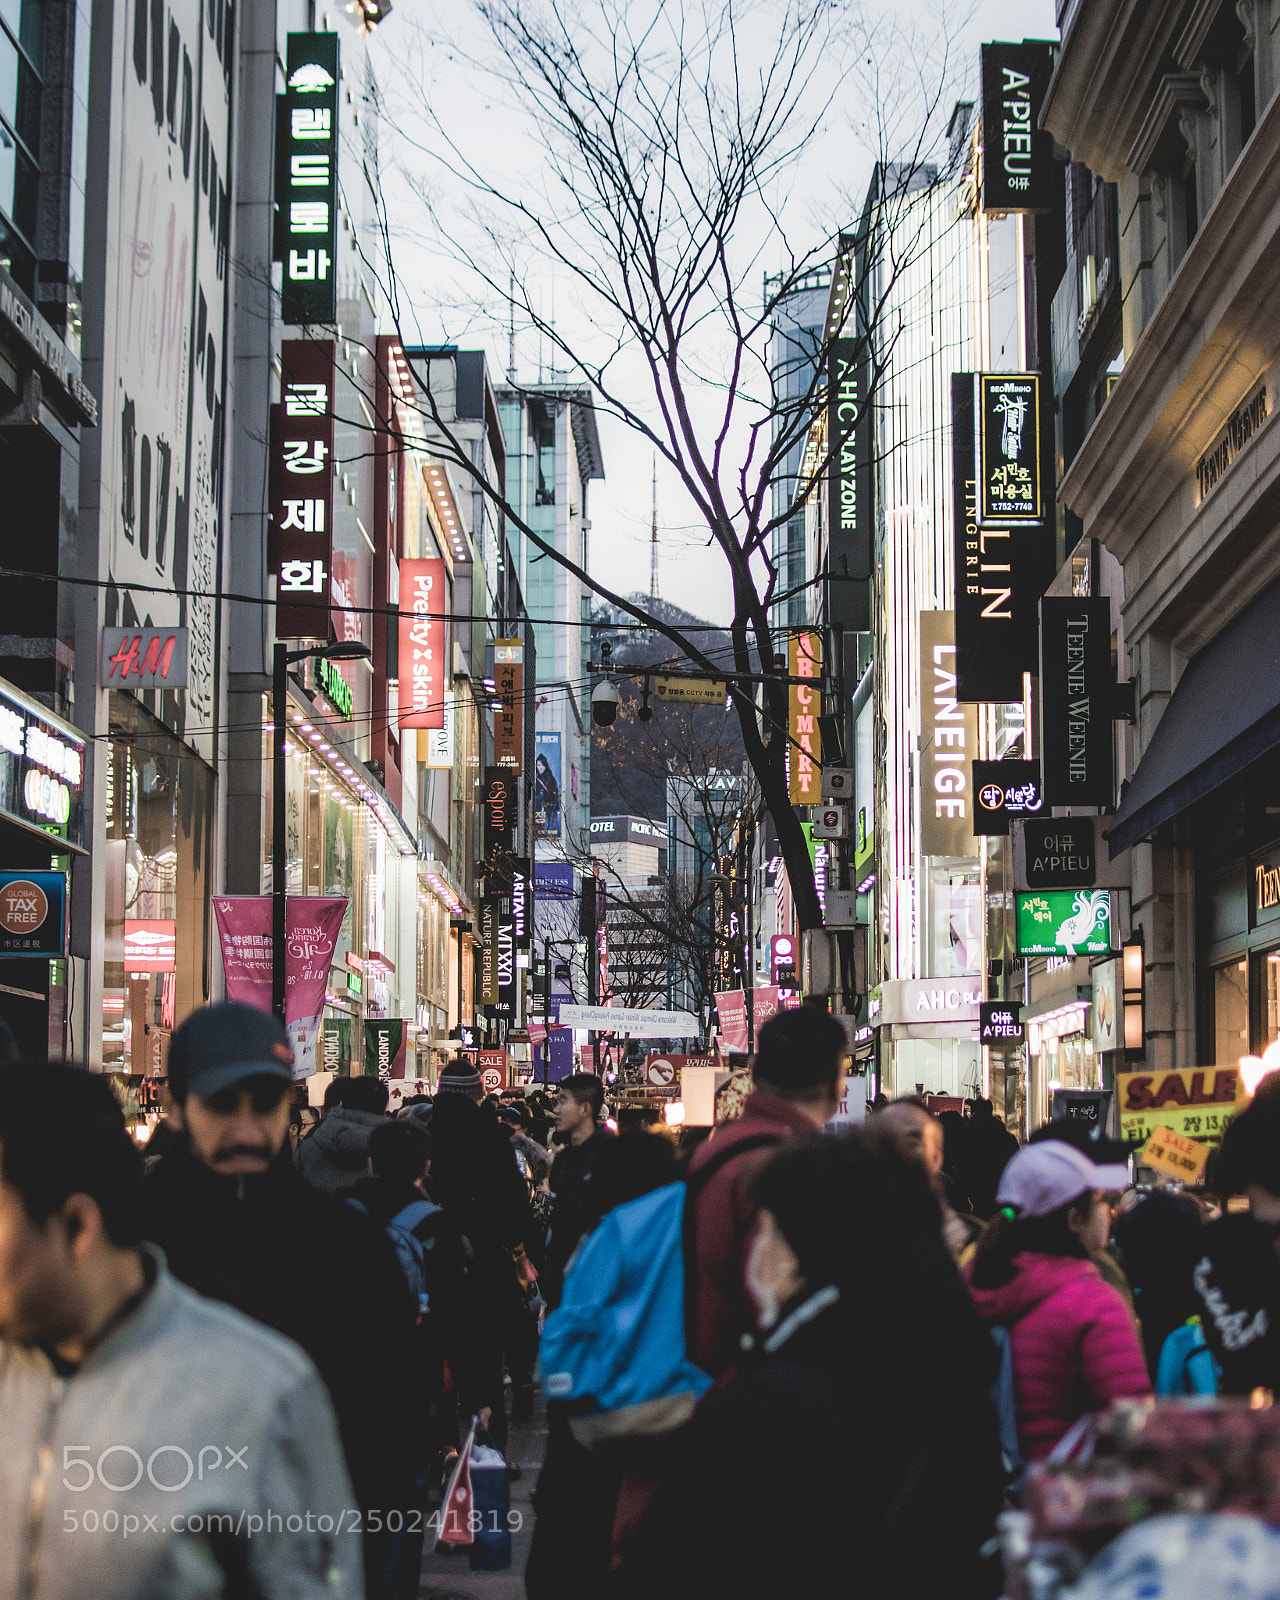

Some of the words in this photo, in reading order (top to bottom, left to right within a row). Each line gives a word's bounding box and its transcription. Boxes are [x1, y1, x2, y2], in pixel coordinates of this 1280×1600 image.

[1002, 67, 1032, 175] A'PIEU
[289, 108, 331, 280] 랜드로바
[280, 383, 329, 593] 금강제화
[990, 462, 1032, 486] 서민호
[990, 483, 1033, 500] 미용실
[840, 478, 857, 529] ZONE
[964, 479, 979, 594] LINGERIE
[979, 530, 1012, 619] LIN
[409, 574, 433, 647] Pretty
[109, 636, 176, 679] H&M
[1066, 614, 1089, 695] TEENIE
[412, 664, 433, 711] skin
[933, 644, 967, 820] LANEIGE
[1068, 695, 1090, 783] WEENIE
[486, 781, 507, 831] espoir
[1032, 856, 1091, 872] A'PIEU
[1044, 834, 1075, 852] 어퓨
[6, 899, 37, 912] TAX
[6, 913, 37, 923] FREE
[483, 904, 492, 946] NATURE
[513, 871, 524, 937] ARITAUM
[1087, 941, 1108, 952] Hair
[482, 948, 492, 998] REPUBLIC
[916, 990, 961, 1011] AHC
[990, 1011, 1013, 1025] 어퓨
[983, 1025, 1022, 1037] A'PIEU
[480, 1056, 503, 1066] SALE
[485, 1075, 499, 1085] 50
[1125, 1069, 1237, 1111] SALE
[1122, 1117, 1145, 1129] NEW
[1163, 1133, 1194, 1155] SALE
